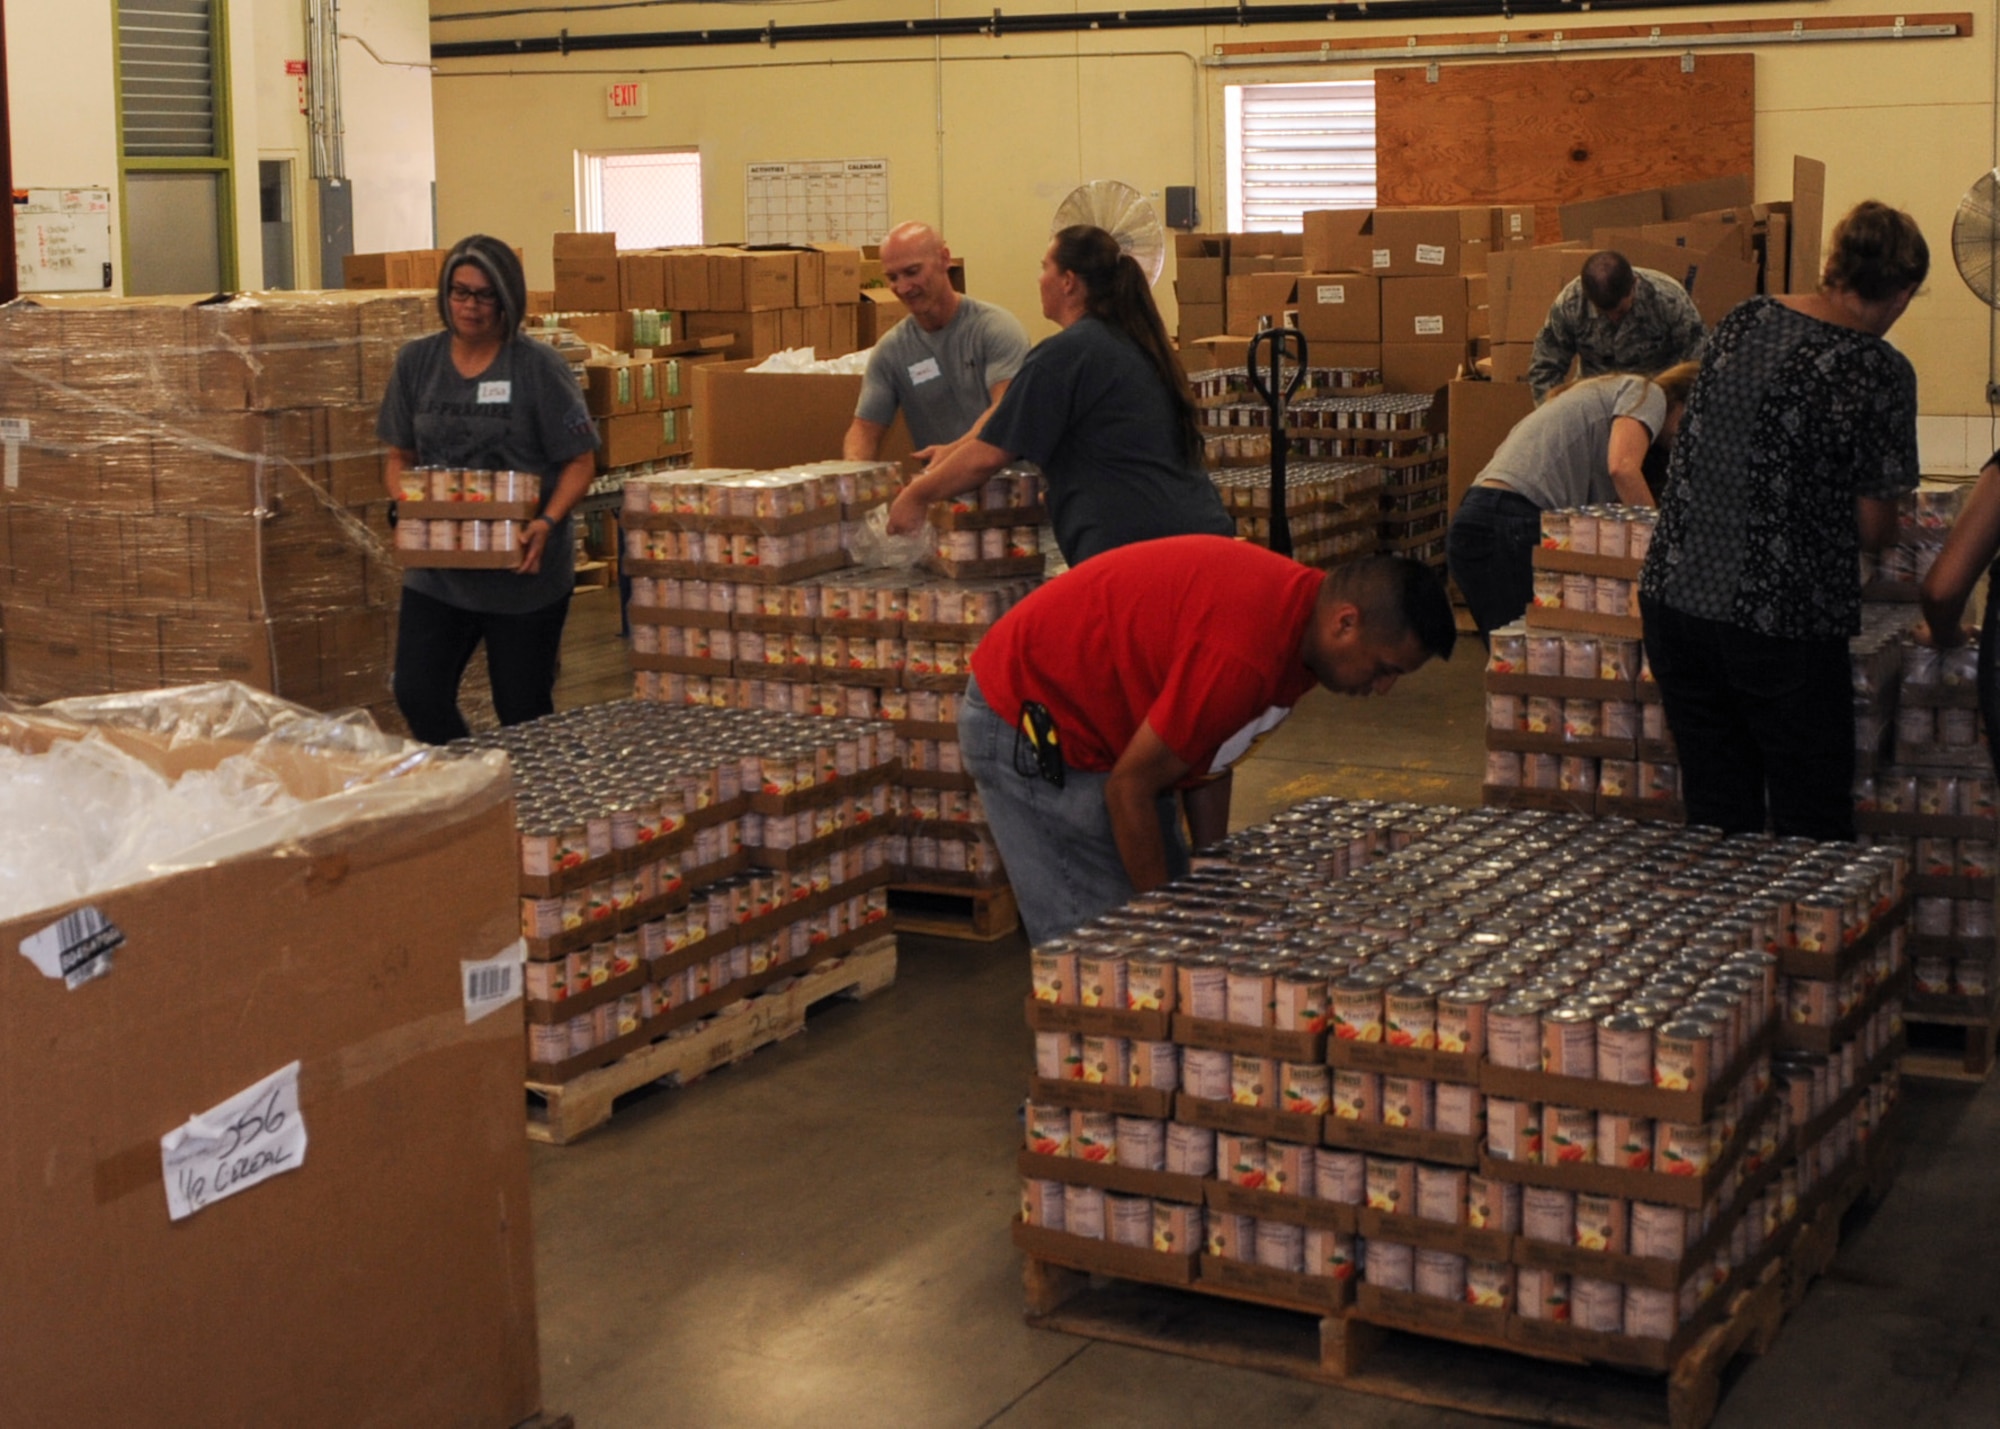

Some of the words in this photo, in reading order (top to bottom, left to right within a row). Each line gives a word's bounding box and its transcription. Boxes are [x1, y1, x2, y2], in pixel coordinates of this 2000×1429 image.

[614, 84, 639, 107] EXIT
[751, 166, 785, 174] ACTIVITIES
[848, 163, 882, 171] CALENDAR
